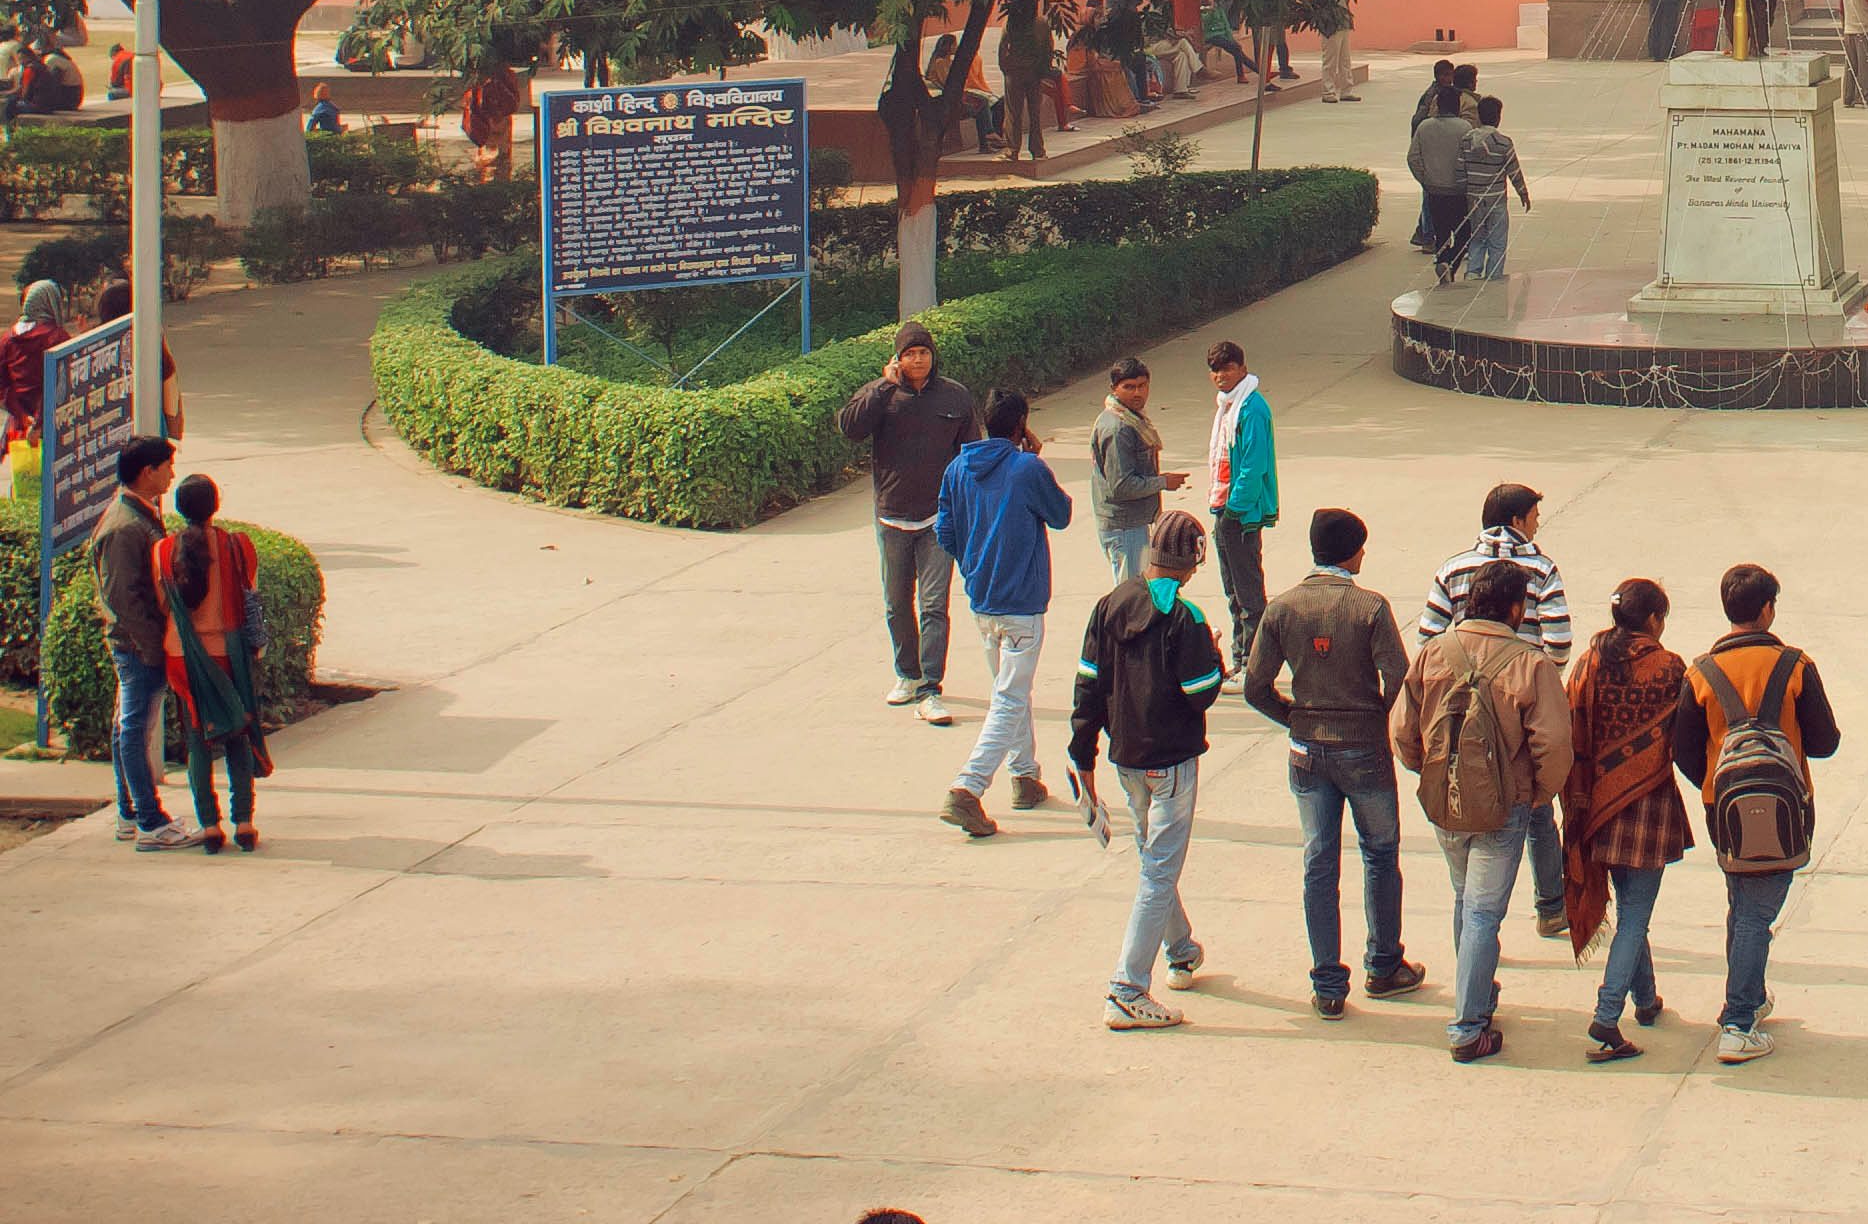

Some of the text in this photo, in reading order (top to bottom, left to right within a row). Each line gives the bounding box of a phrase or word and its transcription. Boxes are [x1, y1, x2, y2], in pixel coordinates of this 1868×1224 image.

[574, 87, 785, 115] काशी हिन्दू विश्वविद्यालय
[556, 105, 795, 139] श्री विश्वनाथ मन्दिर
[1712, 128, 1766, 137] MAHAMANA
[1690, 142, 1720, 150] MADAN
[1723, 142, 1754, 151] MOHAN
